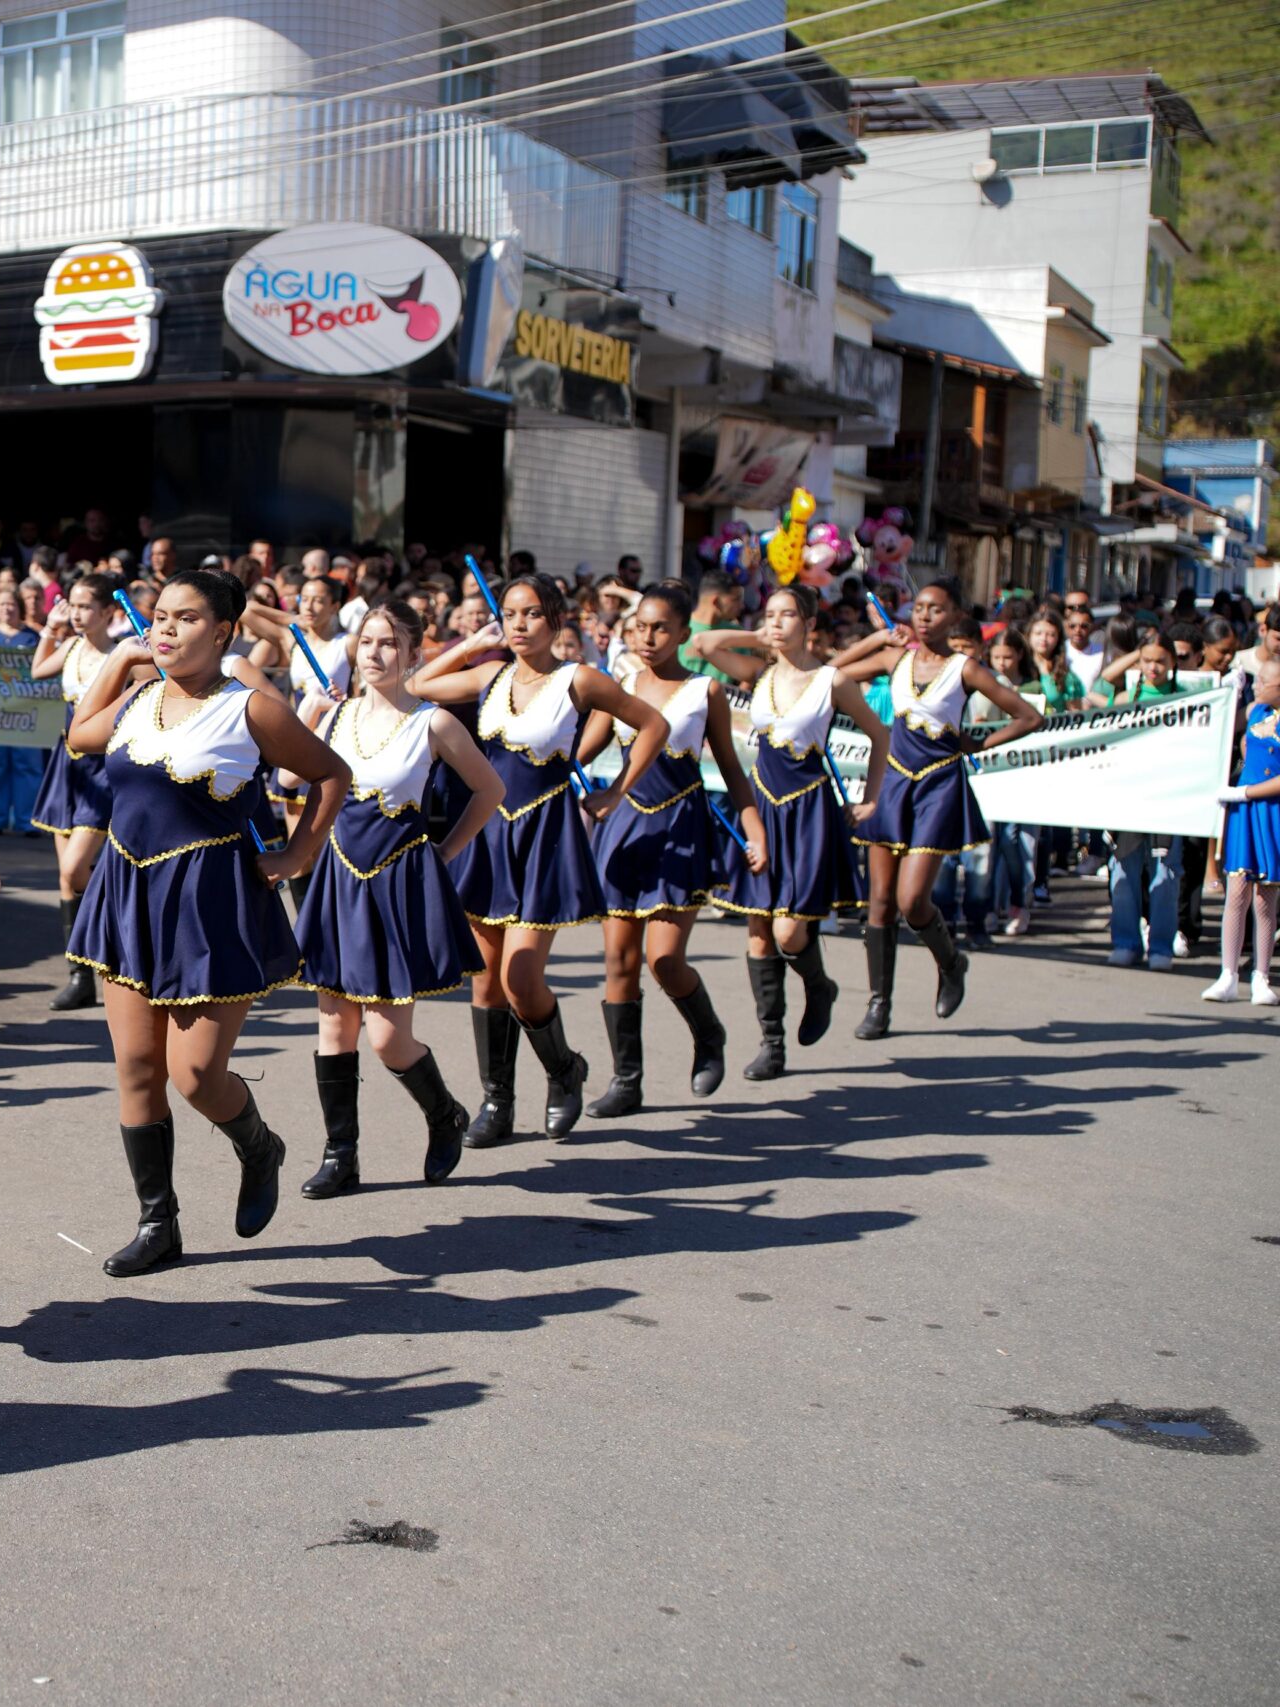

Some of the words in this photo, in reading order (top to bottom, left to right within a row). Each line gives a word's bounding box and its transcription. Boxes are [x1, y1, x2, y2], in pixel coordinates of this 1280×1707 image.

[245, 263, 357, 300] ÁGUA
[253, 302, 281, 316] NA
[284, 301, 380, 336] Boca
[515, 309, 630, 384] SORVETERIA
[0, 680, 11, 697] a
[1006, 749, 1043, 767] em
